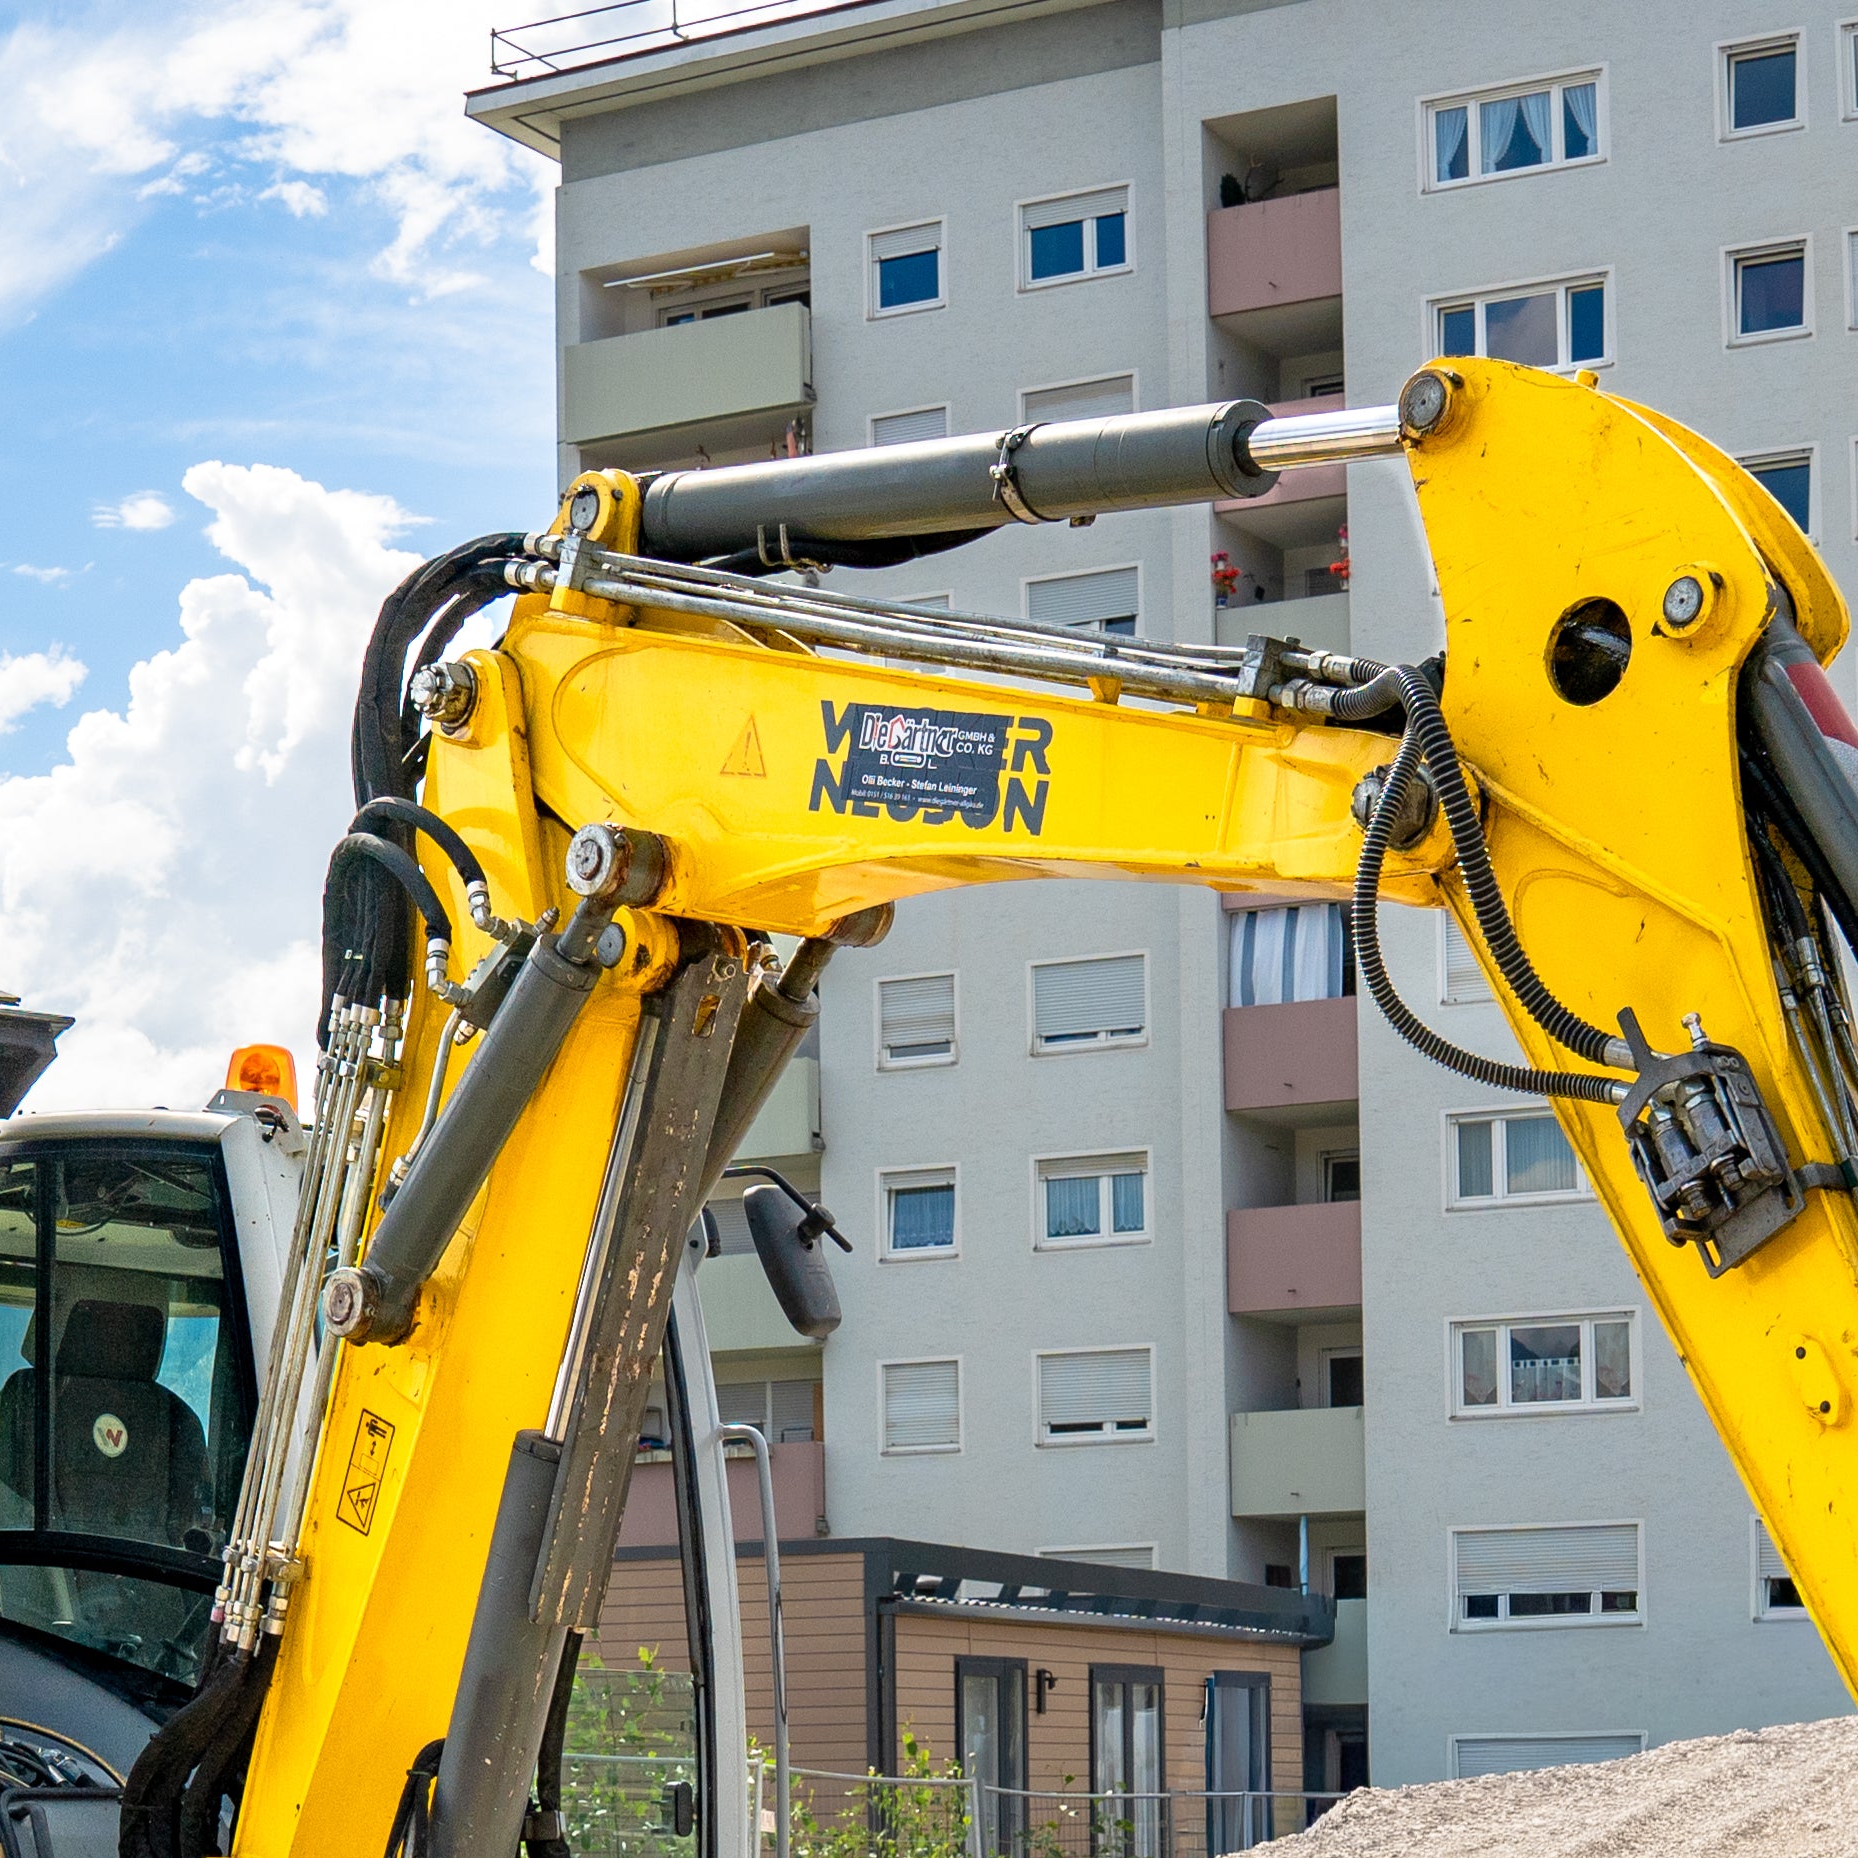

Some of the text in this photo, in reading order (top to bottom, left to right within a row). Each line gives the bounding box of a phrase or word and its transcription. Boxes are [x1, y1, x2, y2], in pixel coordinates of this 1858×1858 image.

[958, 730, 987, 742] GMBH
[988, 733, 996, 743] &
[956, 742, 993, 755] CO. KG
[877, 776, 905, 787] Becker
[911, 779, 937, 791] Stefan
[938, 782, 978, 797] Leininger
